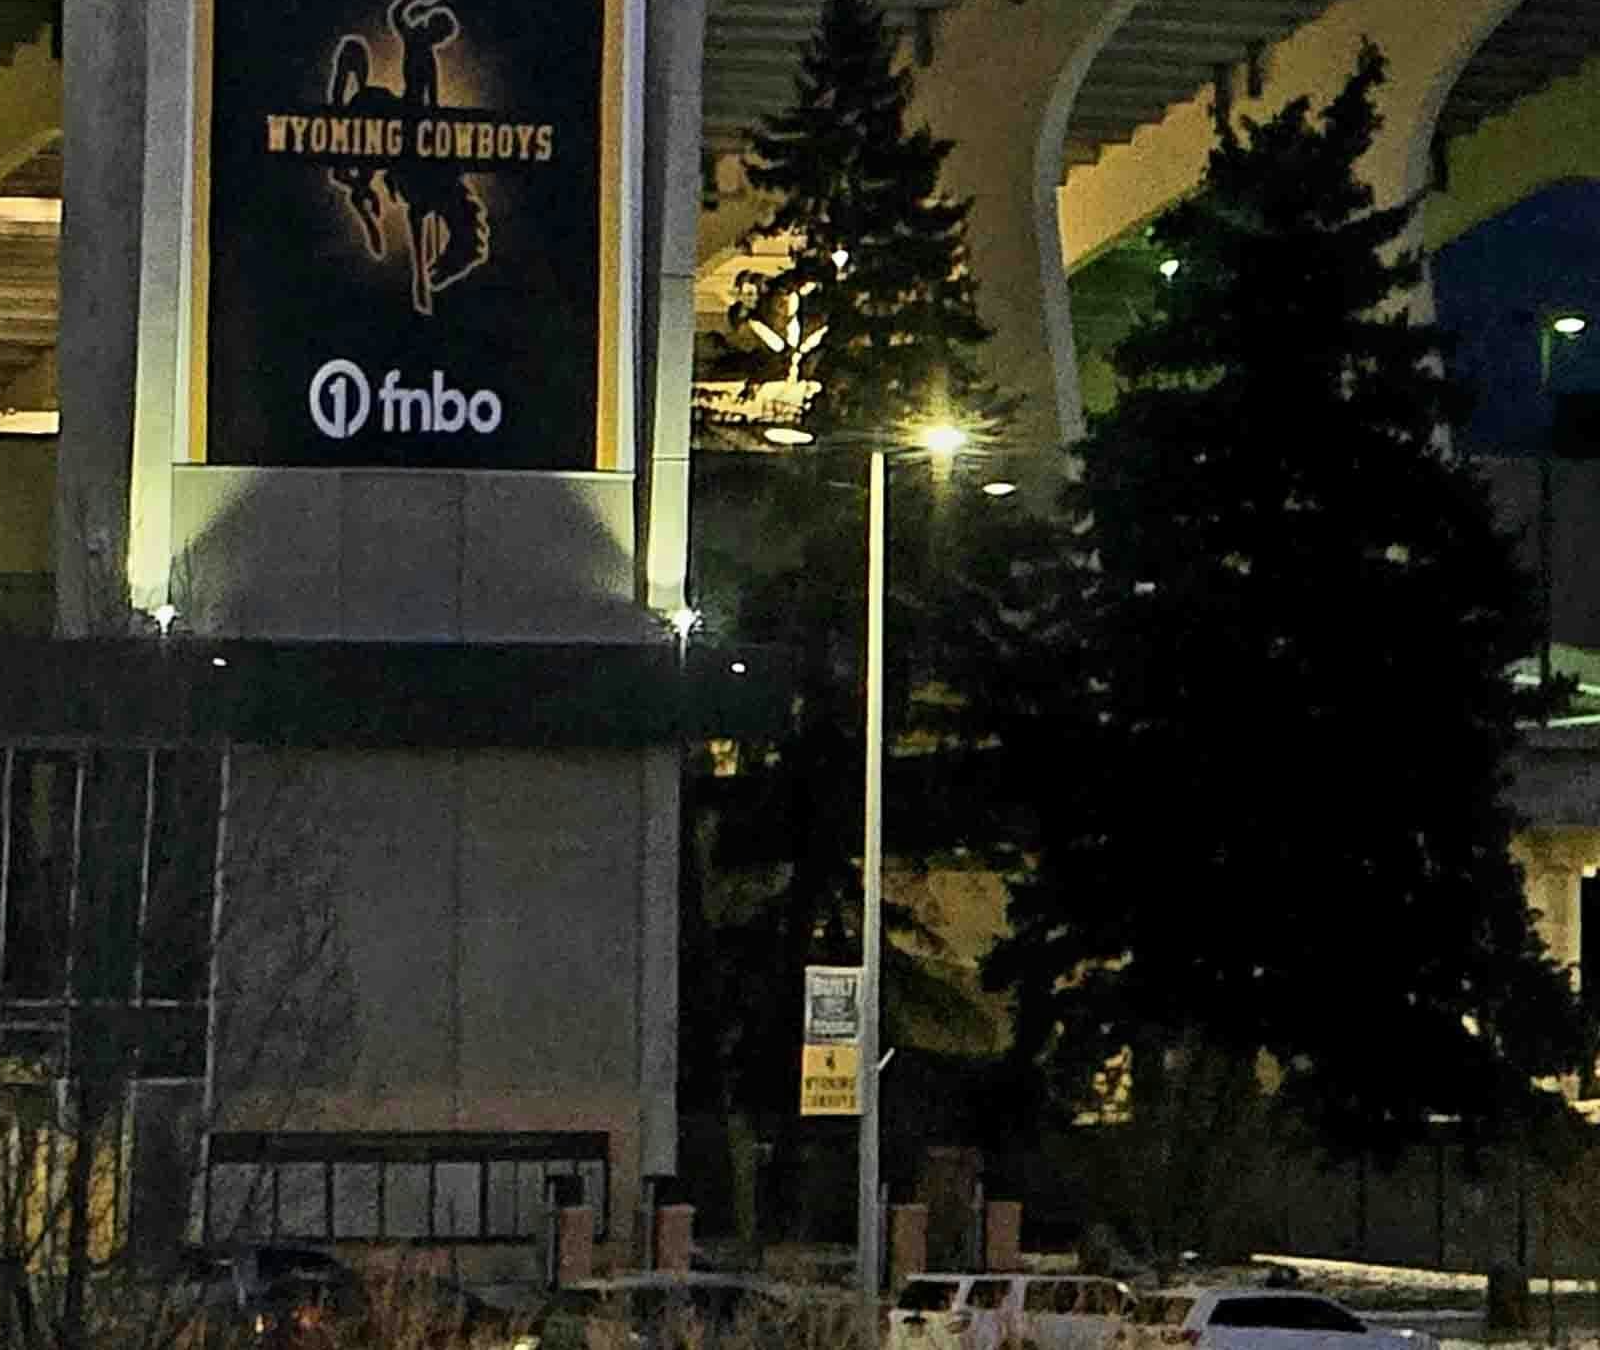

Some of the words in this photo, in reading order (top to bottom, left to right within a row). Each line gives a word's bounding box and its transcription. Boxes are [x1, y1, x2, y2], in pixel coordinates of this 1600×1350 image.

[267, 114, 403, 154] WYOMING
[416, 119, 554, 161] COWBOYS
[378, 367, 502, 434] fnbo
